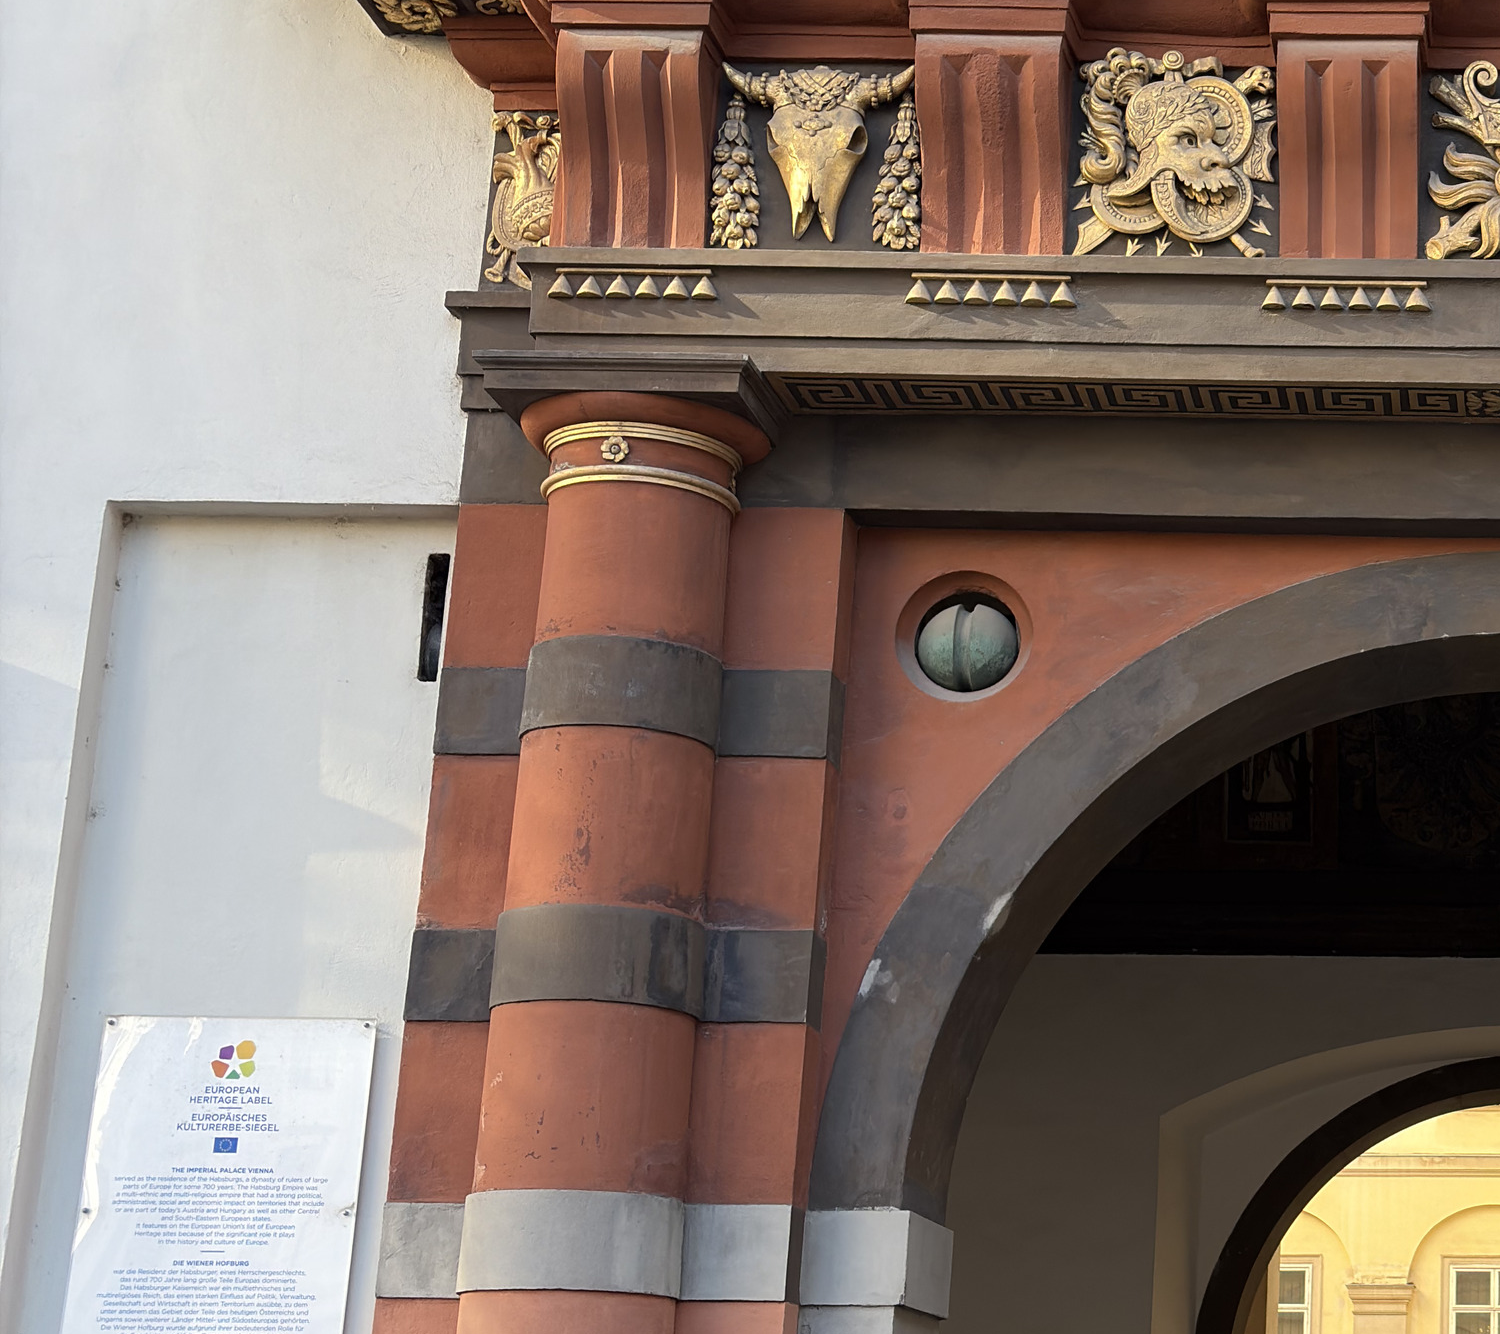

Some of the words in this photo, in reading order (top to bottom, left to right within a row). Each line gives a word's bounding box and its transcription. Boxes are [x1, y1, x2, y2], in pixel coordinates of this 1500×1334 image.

[205, 1086, 260, 1094] EUROPEAN
[189, 1096, 238, 1104] HERITAGE
[191, 1112, 267, 1122] EUROPÄISCHES
[176, 1123, 279, 1132] KULTURERBE-SIEGEL
